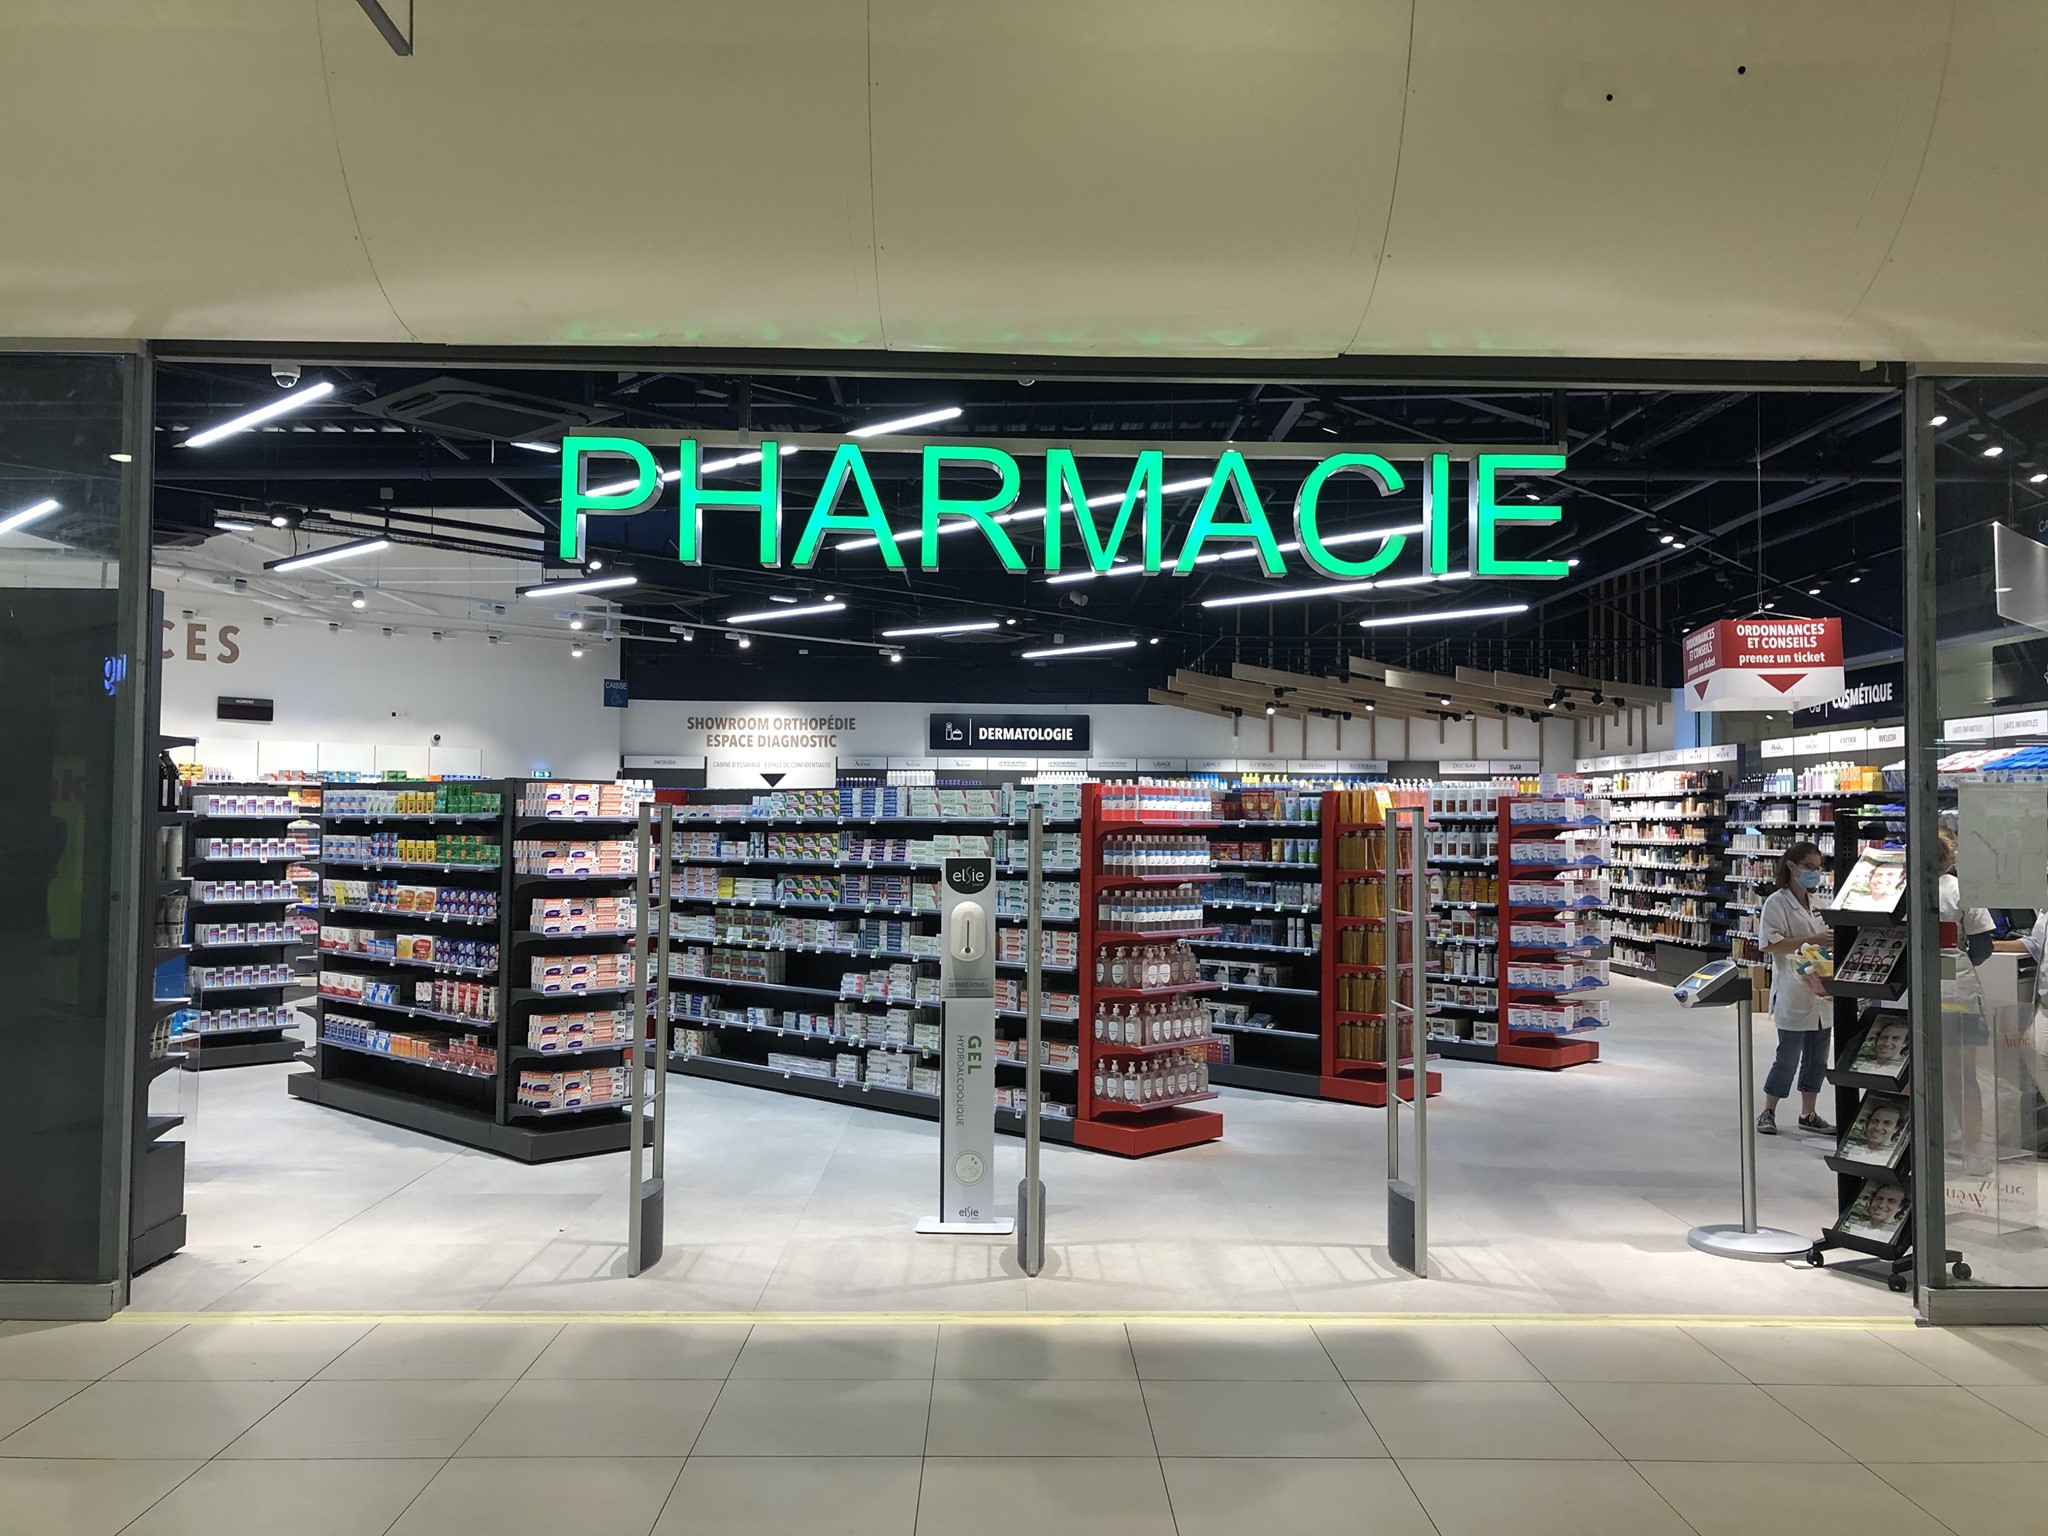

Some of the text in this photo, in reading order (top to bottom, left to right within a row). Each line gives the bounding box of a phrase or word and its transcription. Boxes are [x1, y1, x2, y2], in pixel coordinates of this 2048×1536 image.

[560, 436, 1570, 578] PHARMACIE
[1736, 623, 1825, 636] ORDONNANCES
[1747, 636, 1817, 649] ET CONSEILS
[1739, 651, 1825, 666] prenez un ticket
[605, 681, 627, 690] CAISSE
[687, 714, 856, 731] SHOWROOM ORTHOPÉDIE
[706, 734, 837, 748] ESPACE DIAGNOSTIC
[979, 727, 1073, 741] DERMATOLOGIE
[952, 866, 985, 884] elsie
[967, 1035, 982, 1075] GEL
[956, 1035, 964, 1127] HYDROALCOOLIQUE
[959, 1206, 979, 1218] elsie
